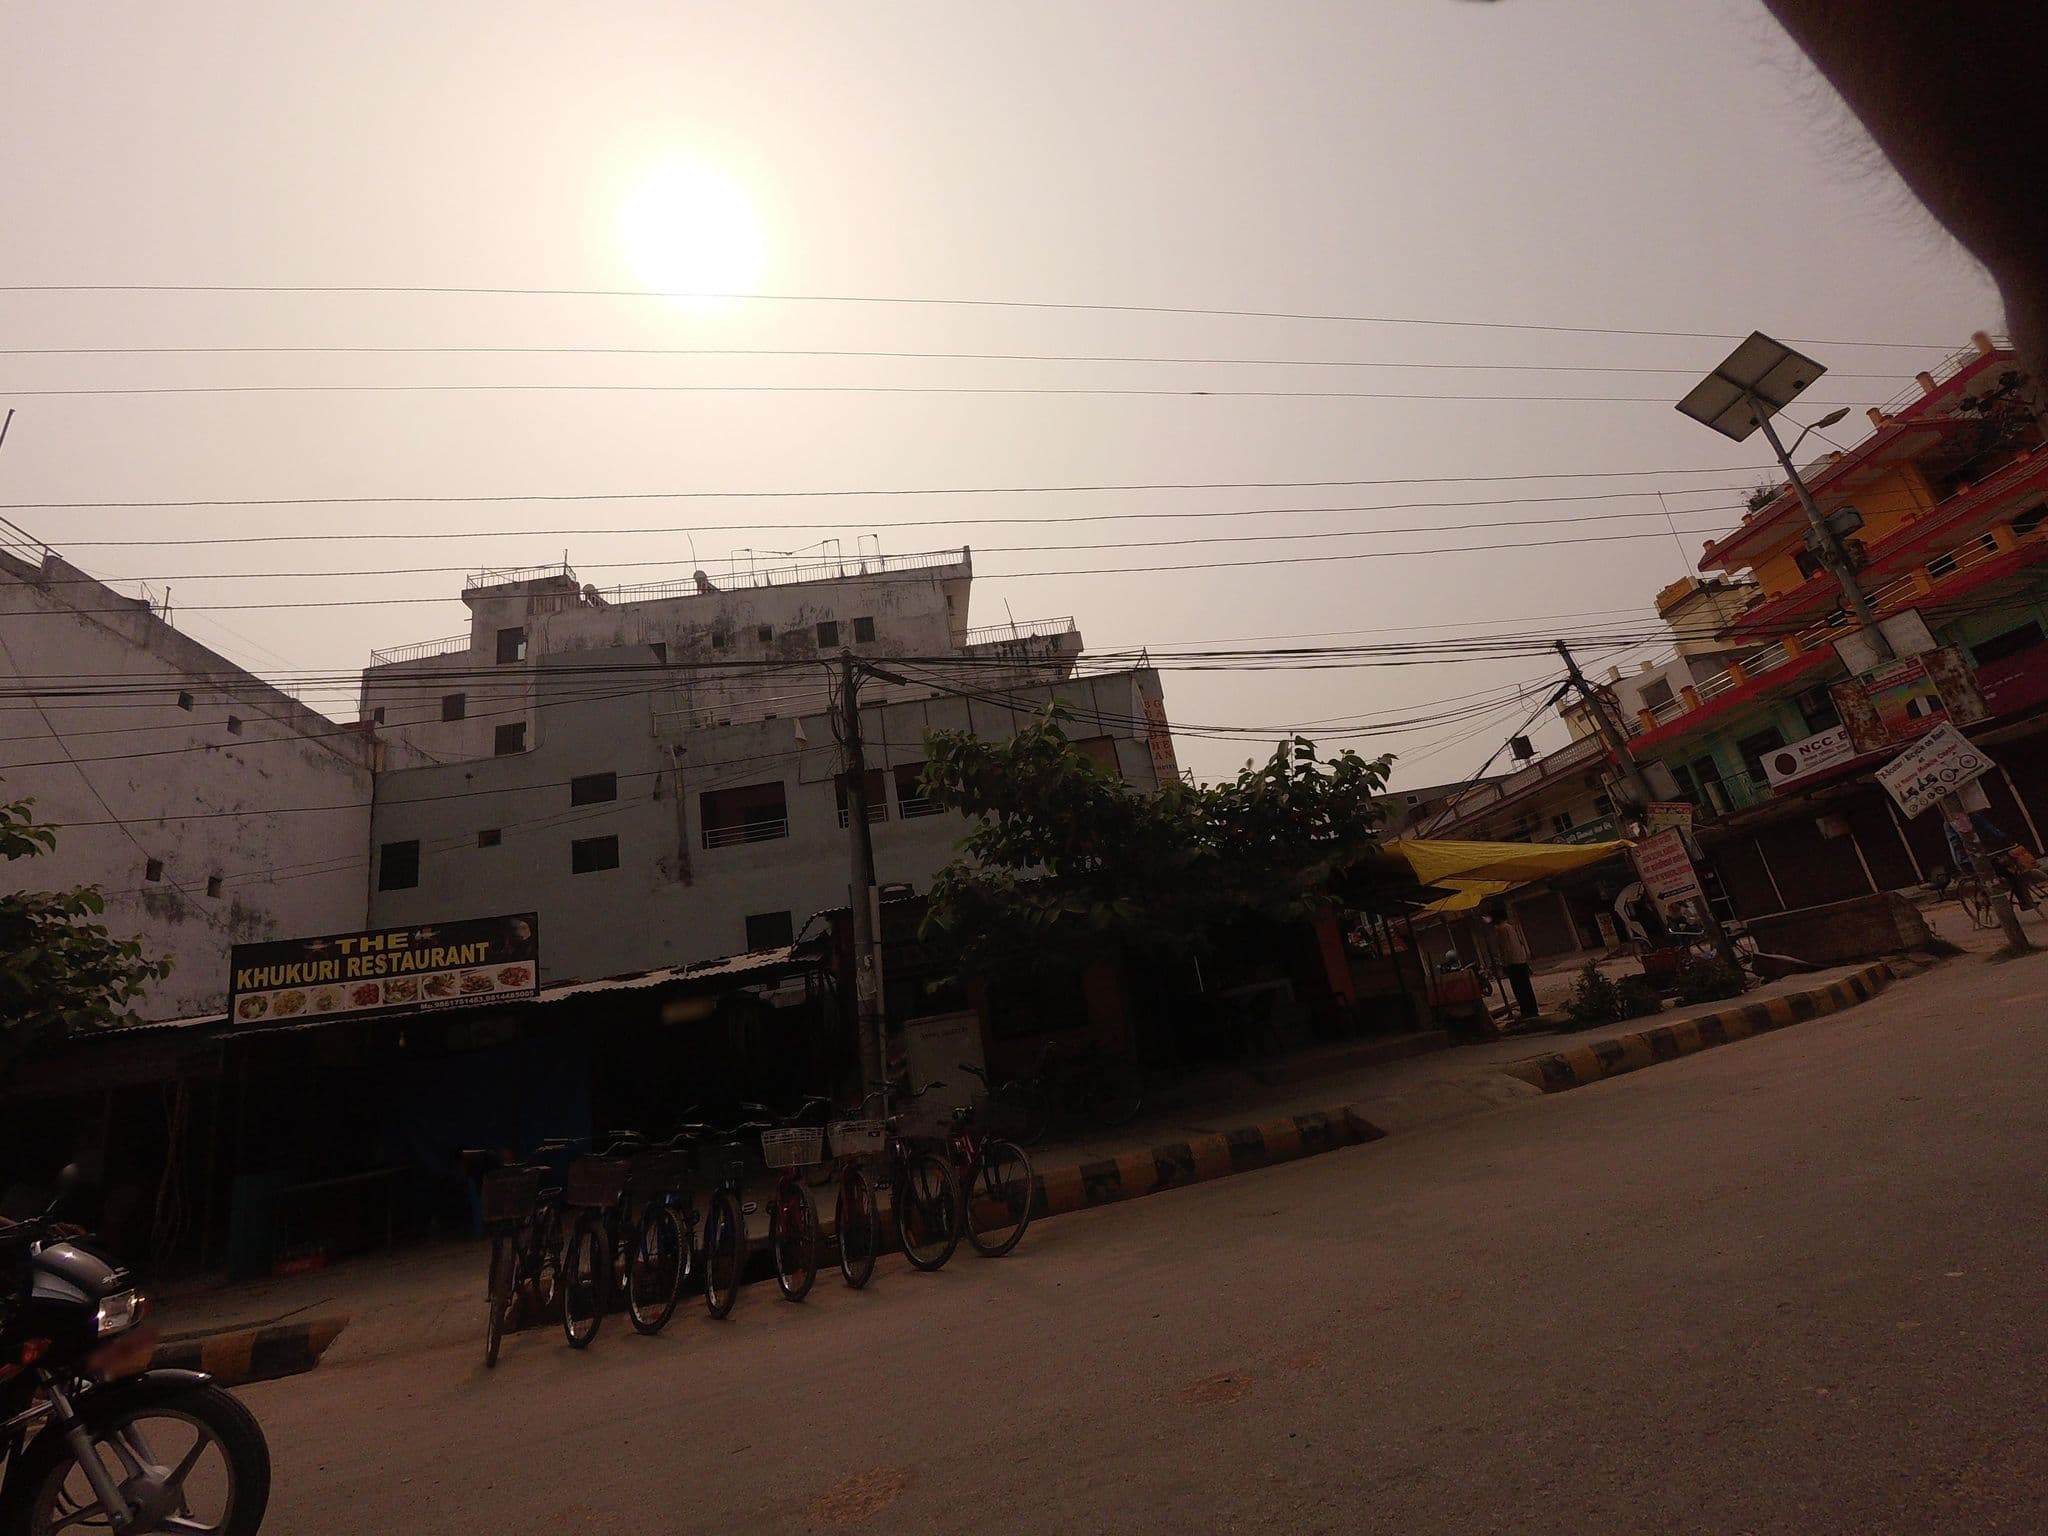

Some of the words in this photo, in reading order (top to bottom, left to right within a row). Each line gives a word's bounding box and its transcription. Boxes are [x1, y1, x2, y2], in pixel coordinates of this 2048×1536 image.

[1798, 736, 1833, 755] NCC
[334, 933, 409, 955] THE
[236, 959, 340, 990] KHUKURI
[347, 941, 490, 978] RESTAURANT
